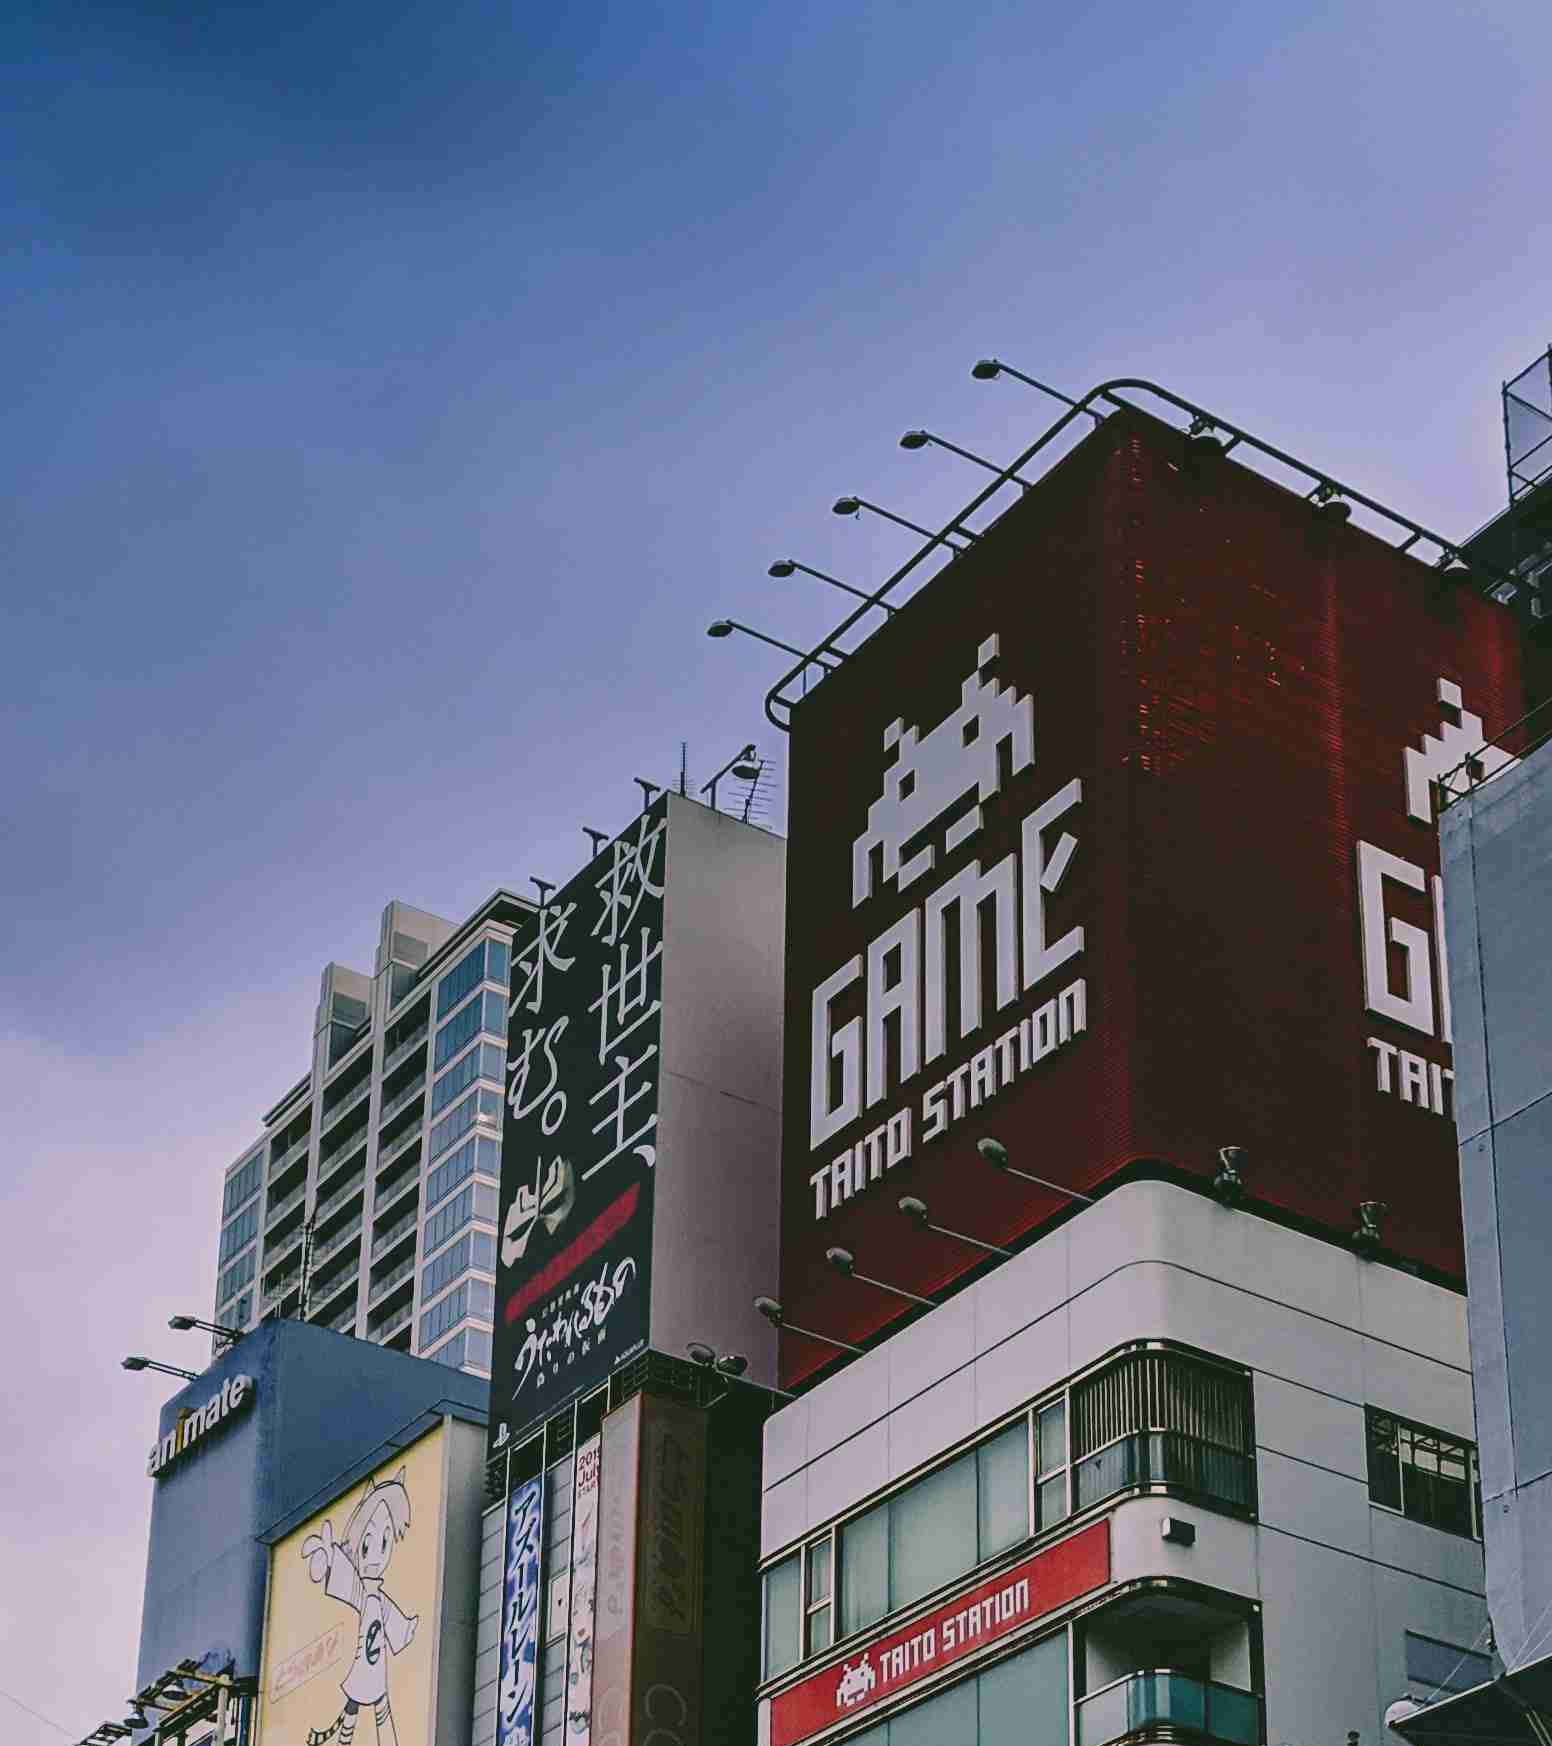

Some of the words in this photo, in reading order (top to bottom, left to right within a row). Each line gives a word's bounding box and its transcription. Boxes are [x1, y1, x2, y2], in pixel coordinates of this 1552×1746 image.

[810, 778, 1085, 1151] GAME
[809, 1107, 912, 1221] TAITO
[921, 977, 1087, 1145] STATION
[146, 1374, 253, 1477] animate
[506, 1489, 540, 1724] アズールレーン
[880, 1633, 937, 1682] TAITO
[943, 1578, 1030, 1654] STATION
